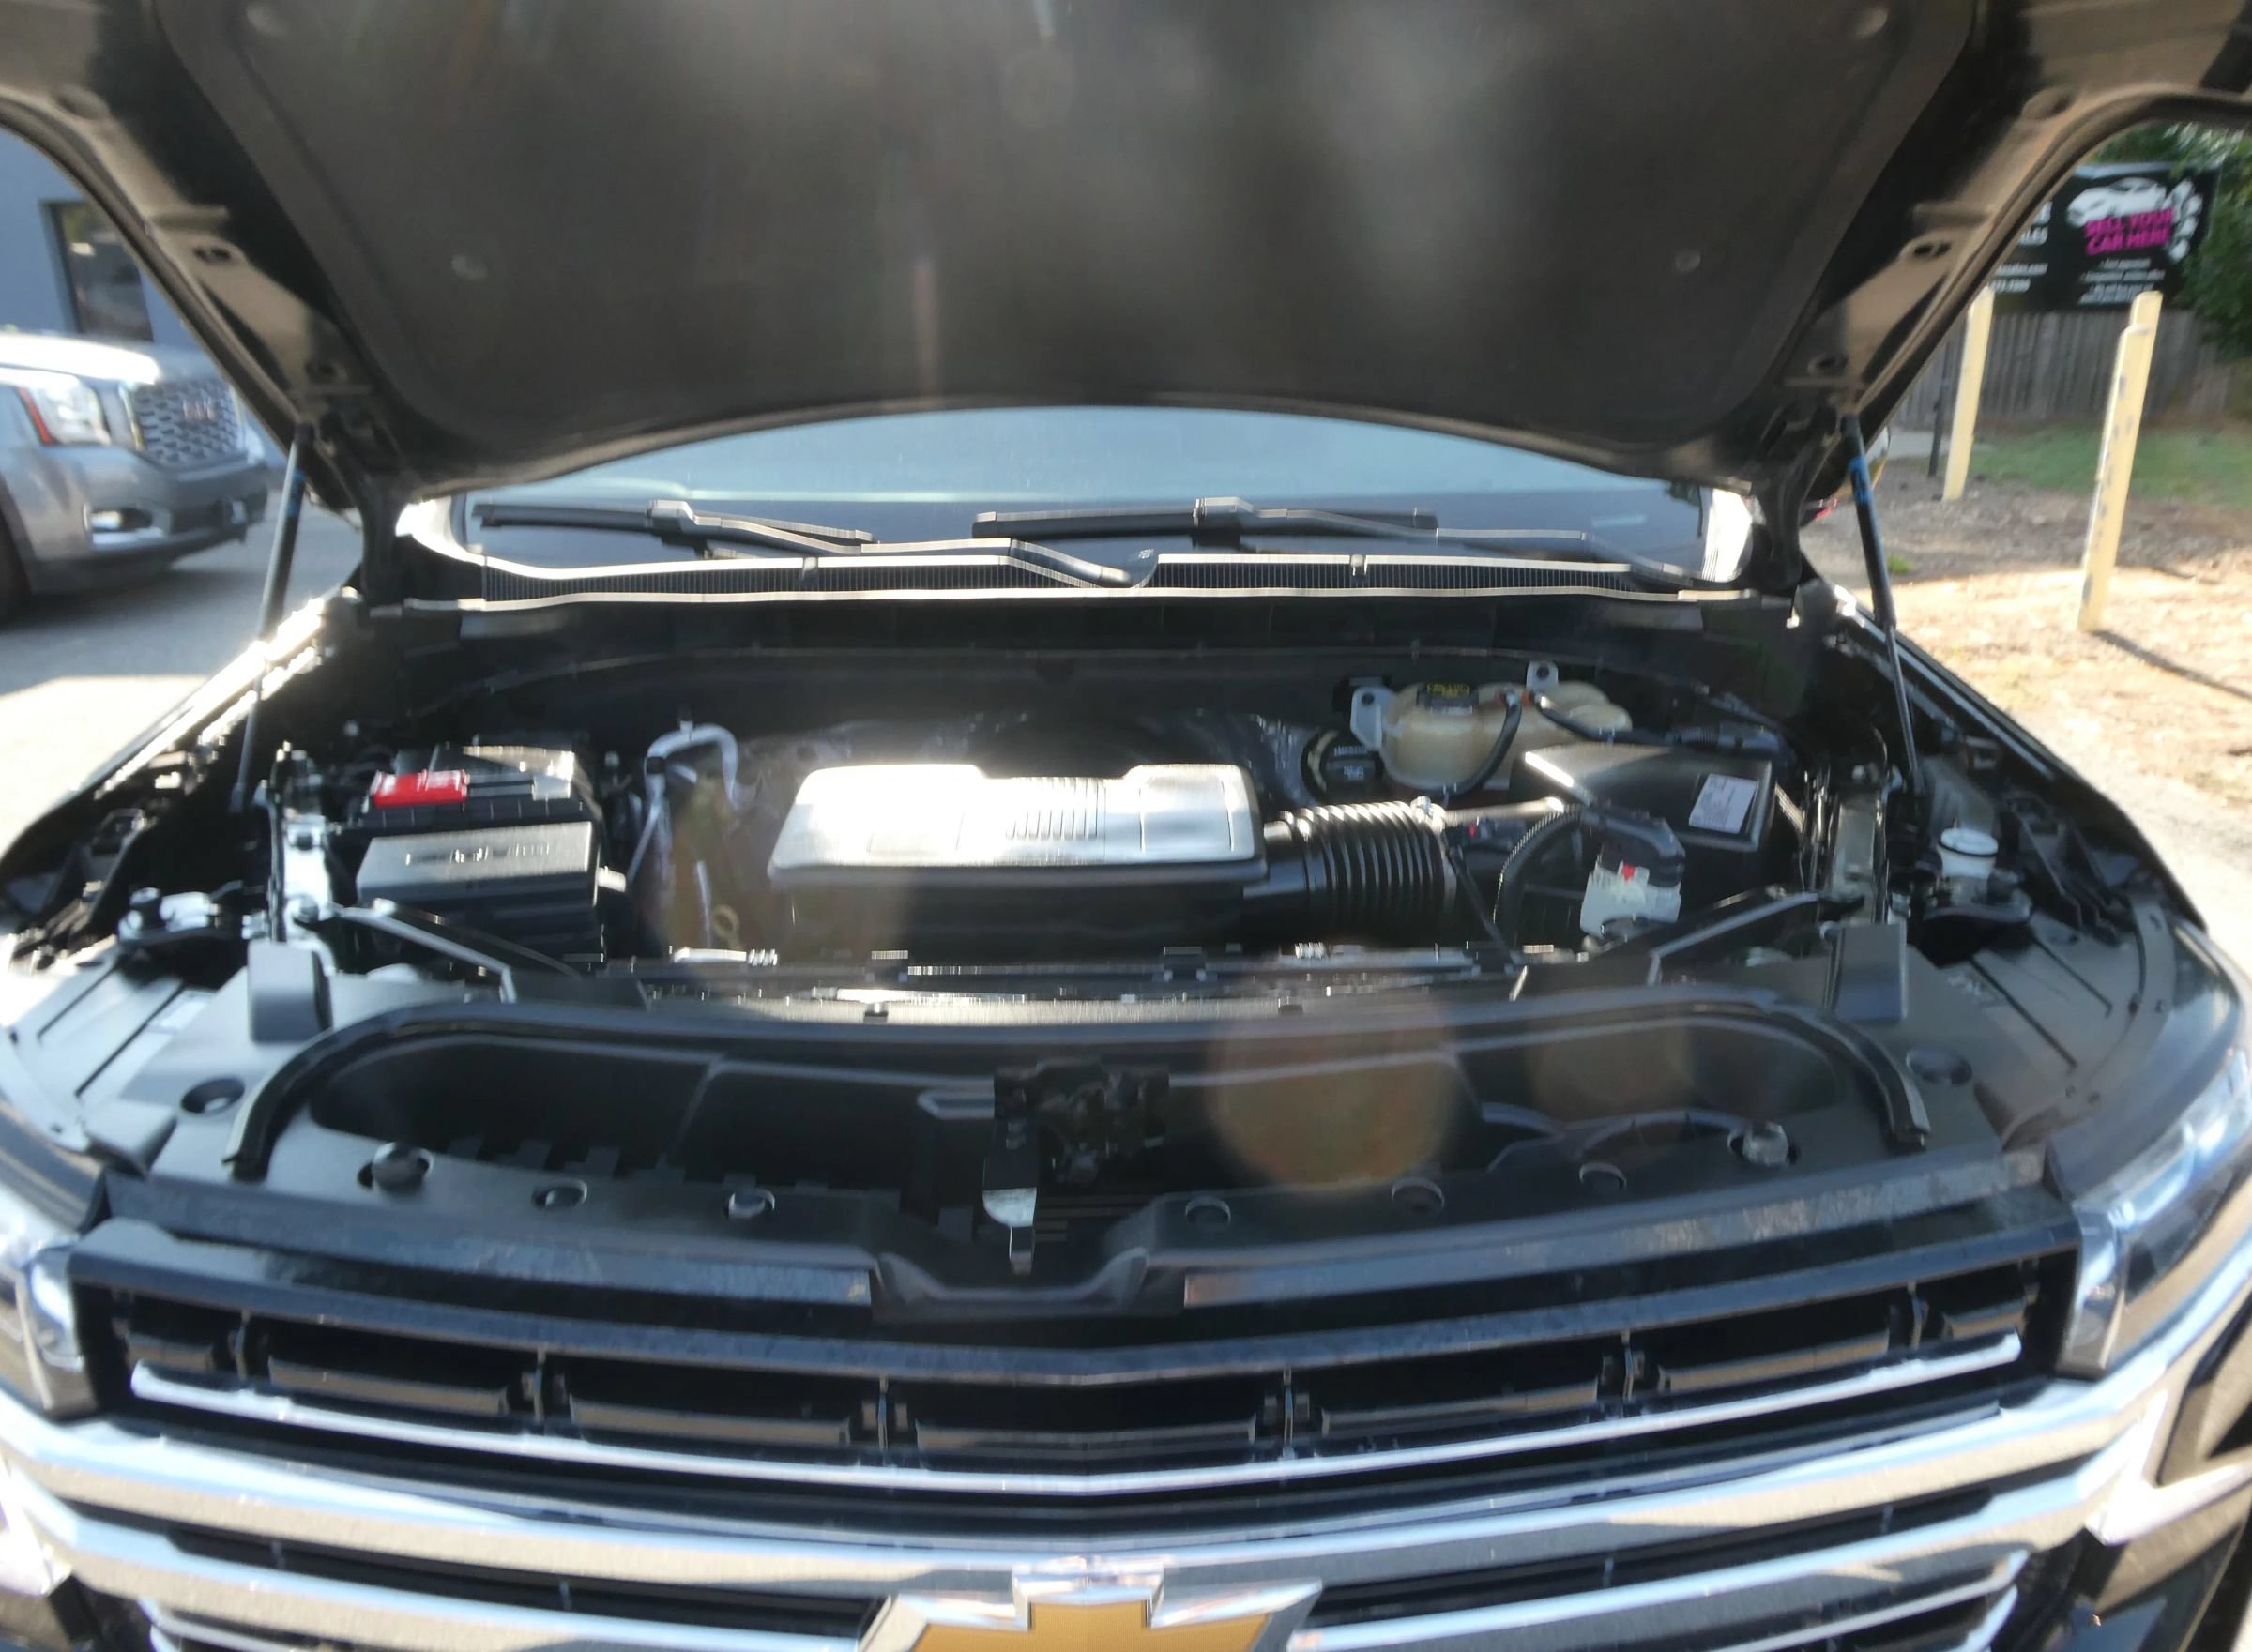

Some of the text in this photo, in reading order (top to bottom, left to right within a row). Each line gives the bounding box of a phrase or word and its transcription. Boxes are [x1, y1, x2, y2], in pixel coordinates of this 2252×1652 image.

[2128, 207, 2173, 232] YOUR
[2086, 224, 2171, 255] CAR HERE
